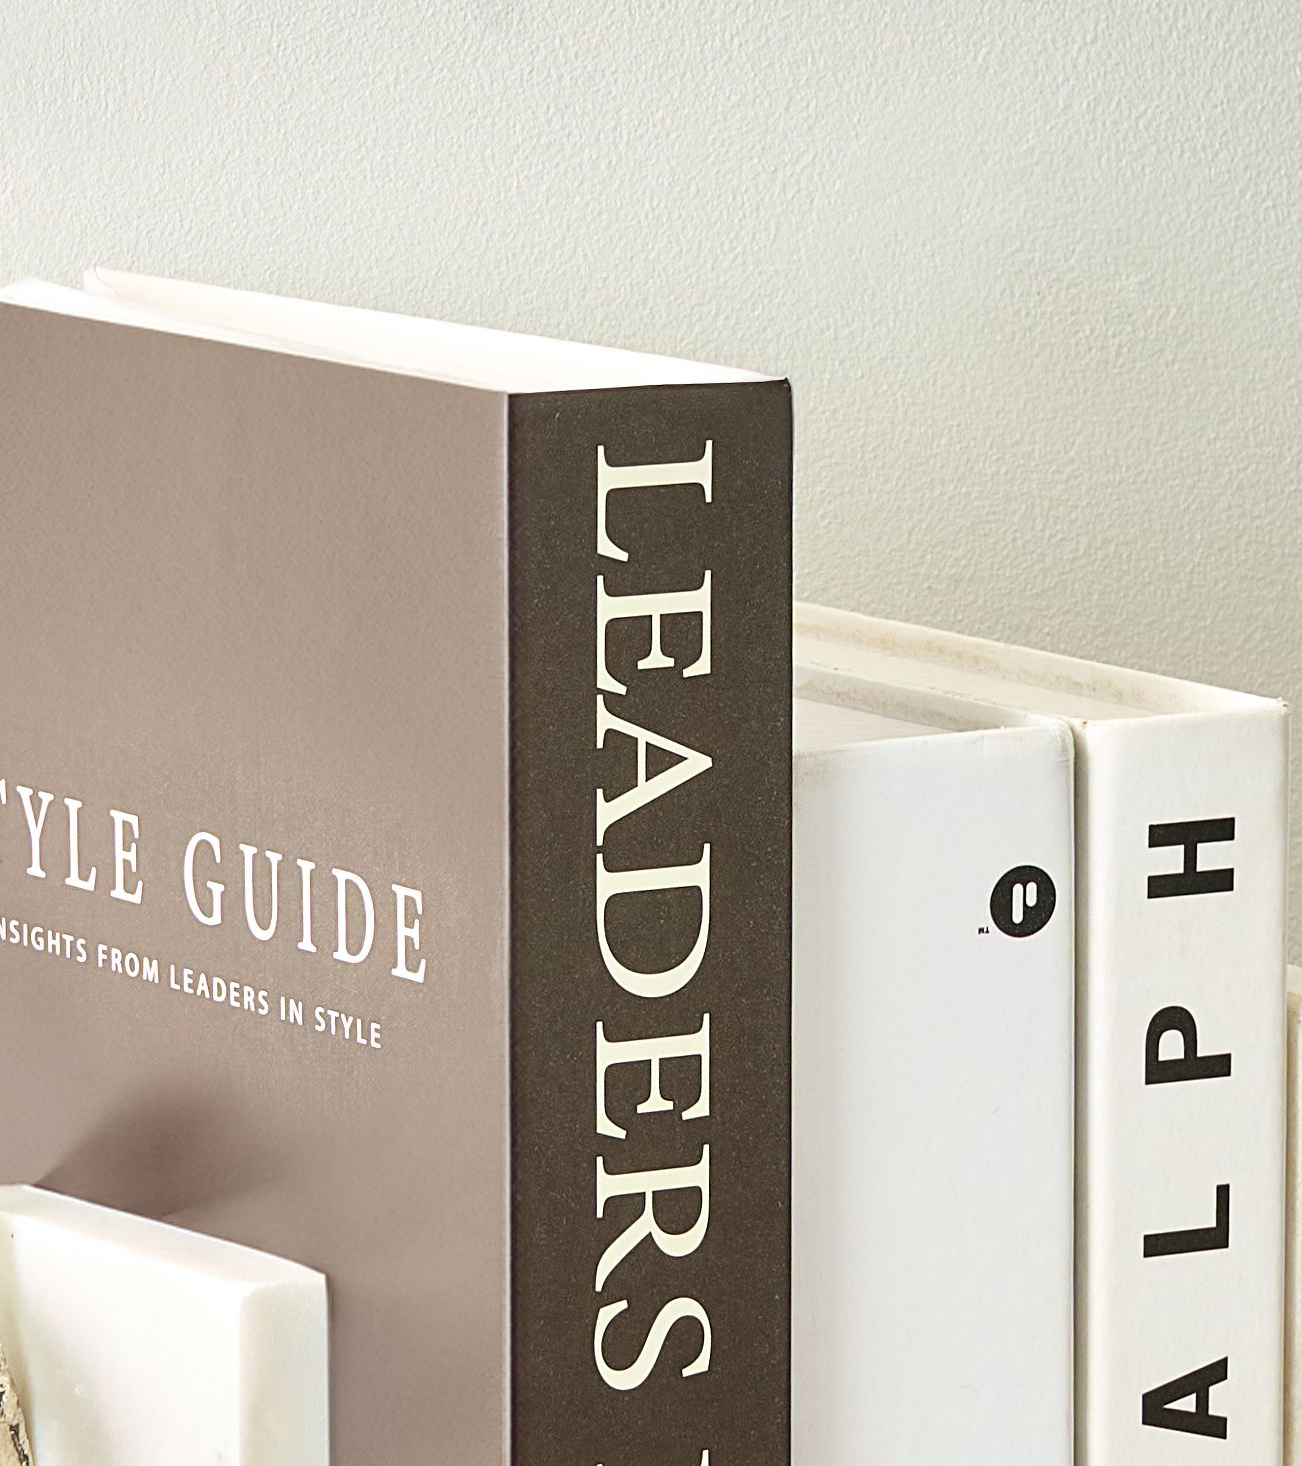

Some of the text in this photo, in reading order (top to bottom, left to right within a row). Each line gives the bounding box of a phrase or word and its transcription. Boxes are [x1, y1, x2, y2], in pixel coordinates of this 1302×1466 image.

[97, 943, 159, 984] FROM
[170, 964, 269, 1016] LEADERS
[280, 996, 303, 1026] IN
[314, 1006, 382, 1049] STYLE
[183, 831, 427, 984] GUIDE
[594, 438, 713, 1392] LEADERS
[1141, 816, 1236, 1440] ALPH
